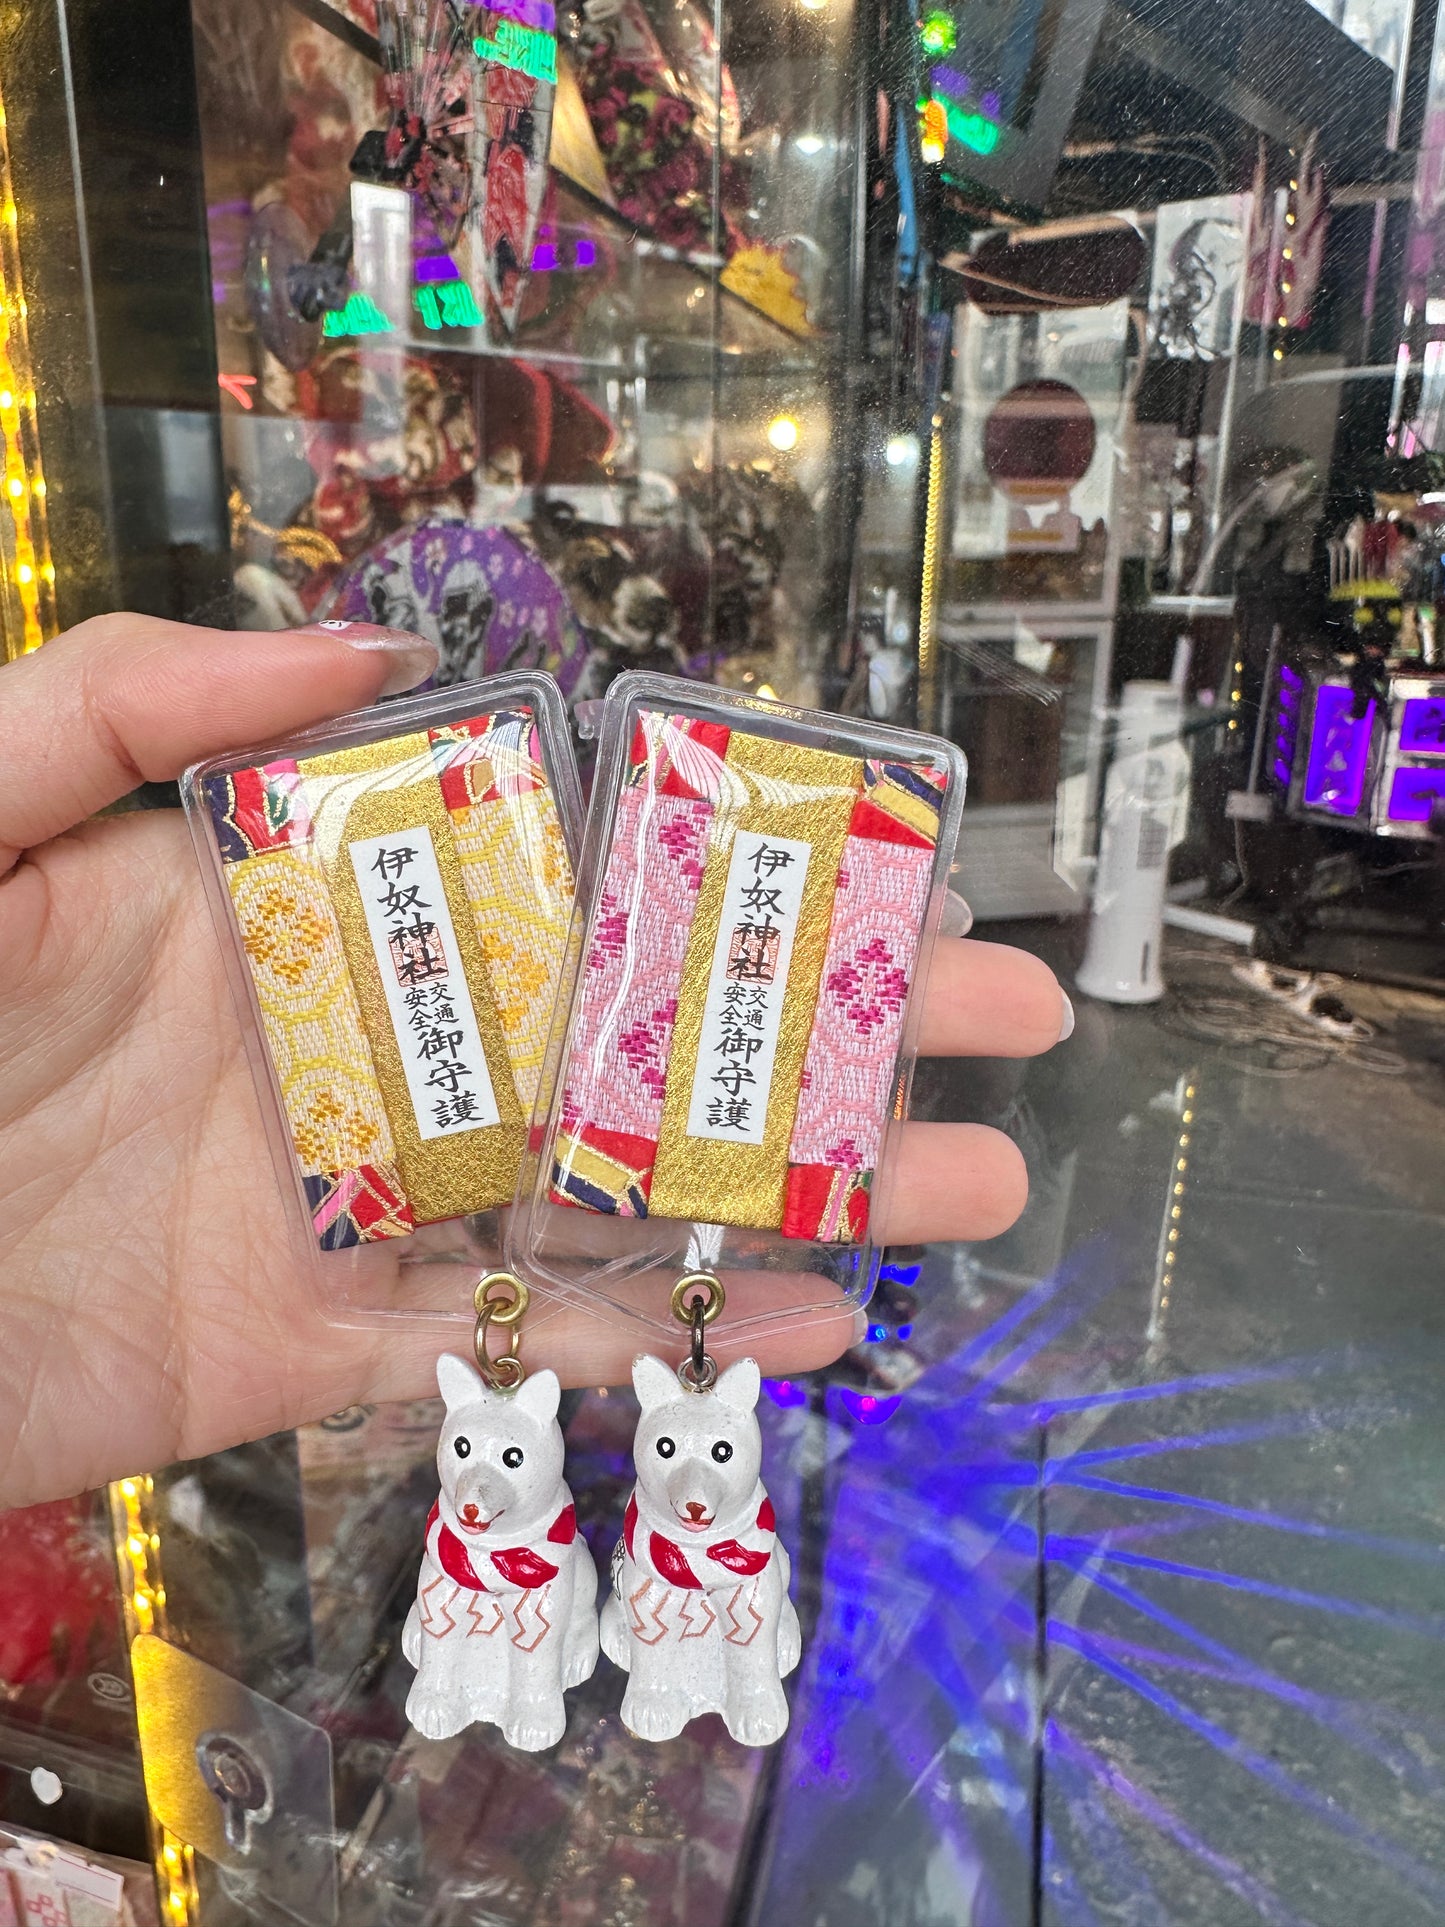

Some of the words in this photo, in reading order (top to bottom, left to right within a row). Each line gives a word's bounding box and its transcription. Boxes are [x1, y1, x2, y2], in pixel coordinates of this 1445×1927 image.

[370, 847, 448, 985] 伊奴神社
[727, 842, 795, 981] 伊奴神社
[403, 986, 433, 1032] 安全
[429, 982, 459, 1025] 交通
[718, 982, 747, 1027] 安全
[742, 985, 769, 1031] 交通
[416, 1028, 485, 1129] 御守護
[706, 1027, 764, 1132] 御守護
